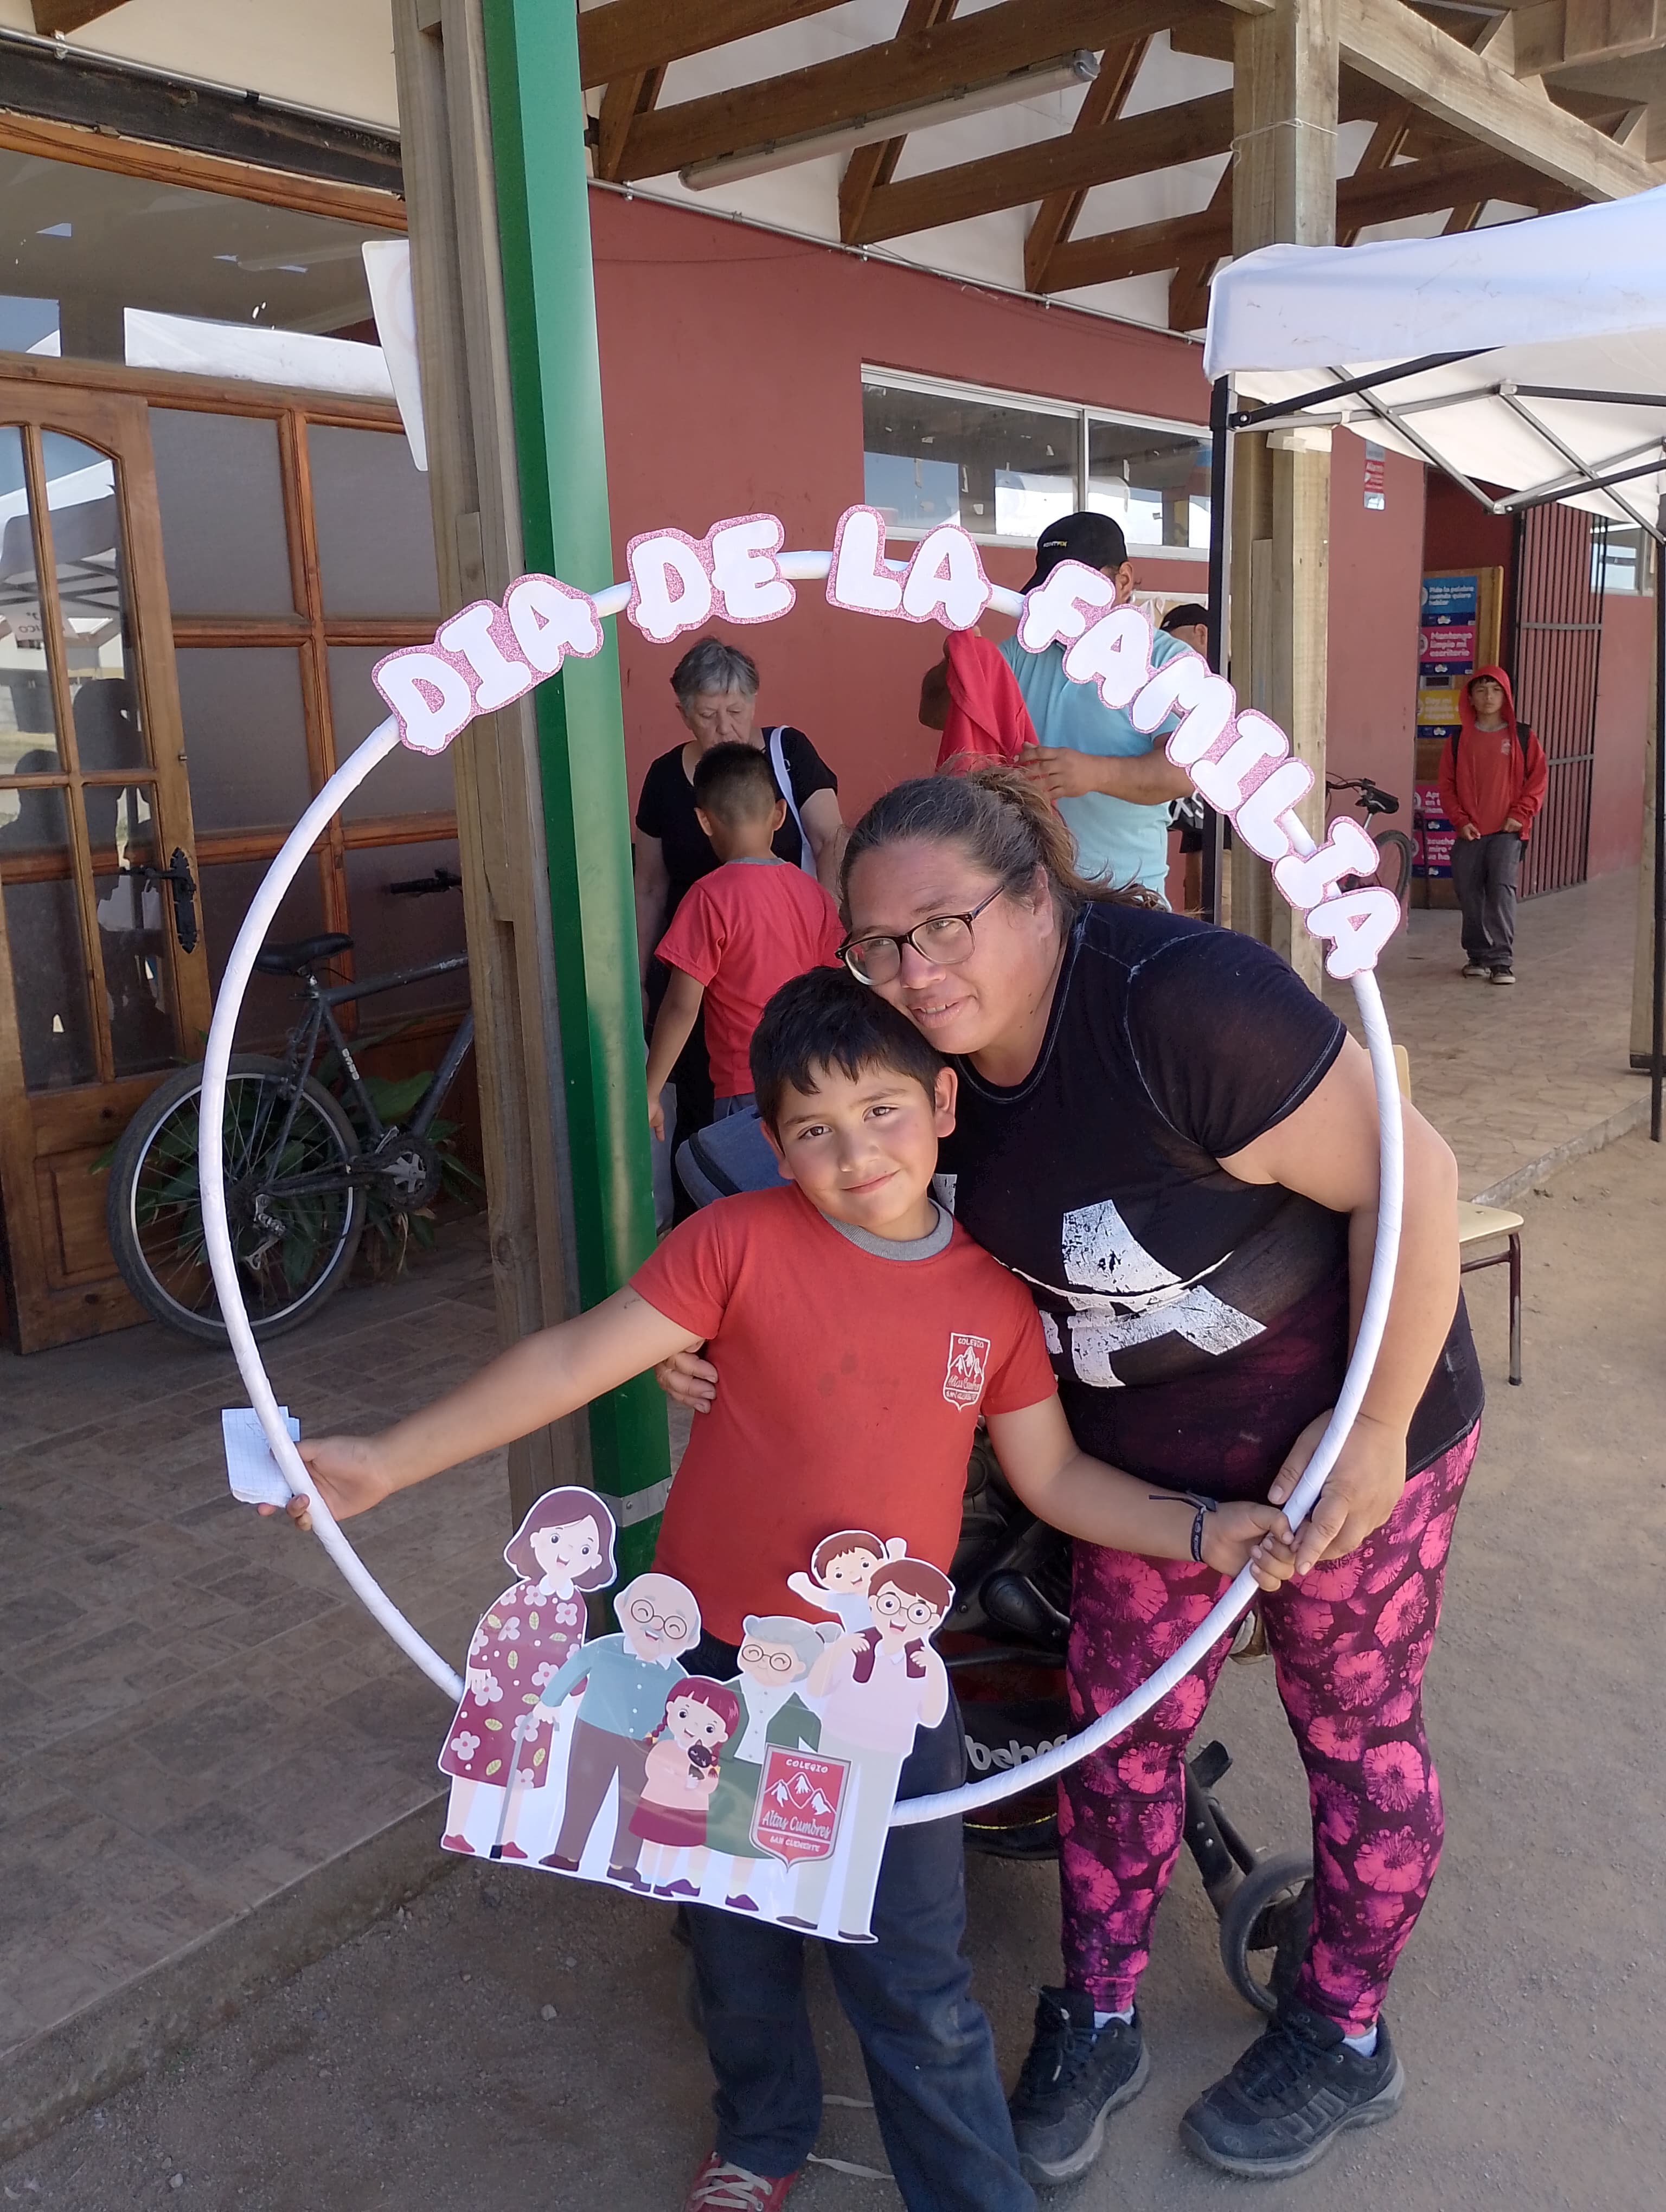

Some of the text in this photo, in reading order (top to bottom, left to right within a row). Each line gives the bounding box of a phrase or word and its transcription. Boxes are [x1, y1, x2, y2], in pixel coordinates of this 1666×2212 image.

[1431, 632, 1472, 642] Mantengo
[371, 504, 1401, 980] DIA DE LA FAMILIA
[785, 1758, 829, 1773] COLEGIO
[762, 1810, 831, 1839] Altas Cumbres
[770, 1835, 821, 1852] SAN CLEMENTE
